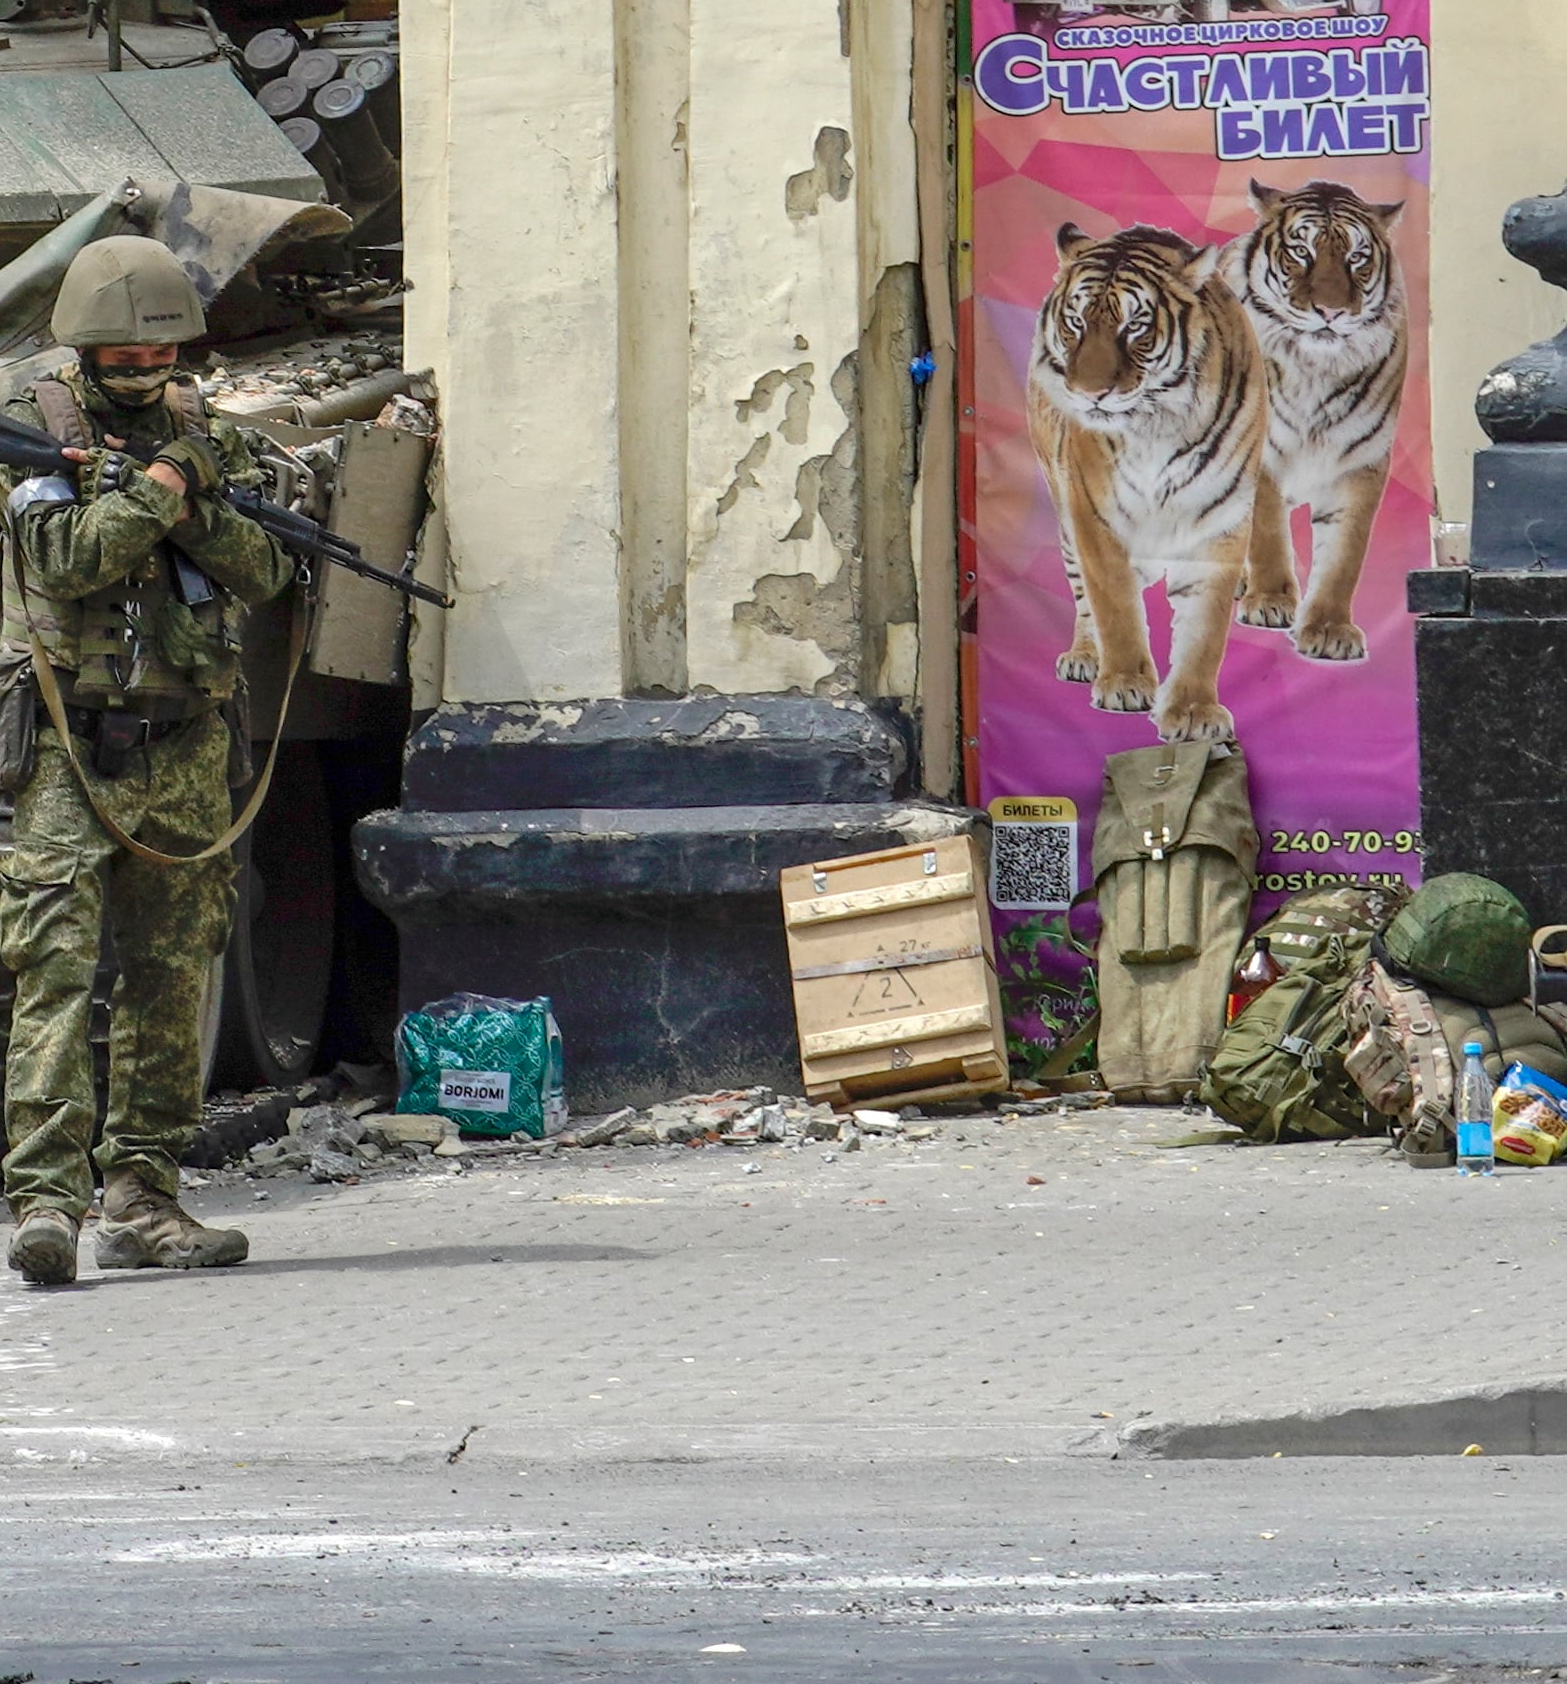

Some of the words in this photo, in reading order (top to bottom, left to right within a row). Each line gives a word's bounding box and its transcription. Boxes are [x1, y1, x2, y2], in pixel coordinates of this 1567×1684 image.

[1058, 27, 1195, 47] СКАЗОЧНОЕ
[1201, 22, 1326, 44] ЦИРКОВОЕ
[1332, 16, 1387, 36] ШОУ
[980, 38, 1426, 112] СЧАСТЛИВЫЙ
[1223, 103, 1426, 156] БИЛЕТ
[1002, 804, 1063, 817] БИЛЕТЫ
[899, 939, 917, 953] 27
[879, 976, 893, 999] 2
[444, 1083, 504, 1101] BORJOMI
